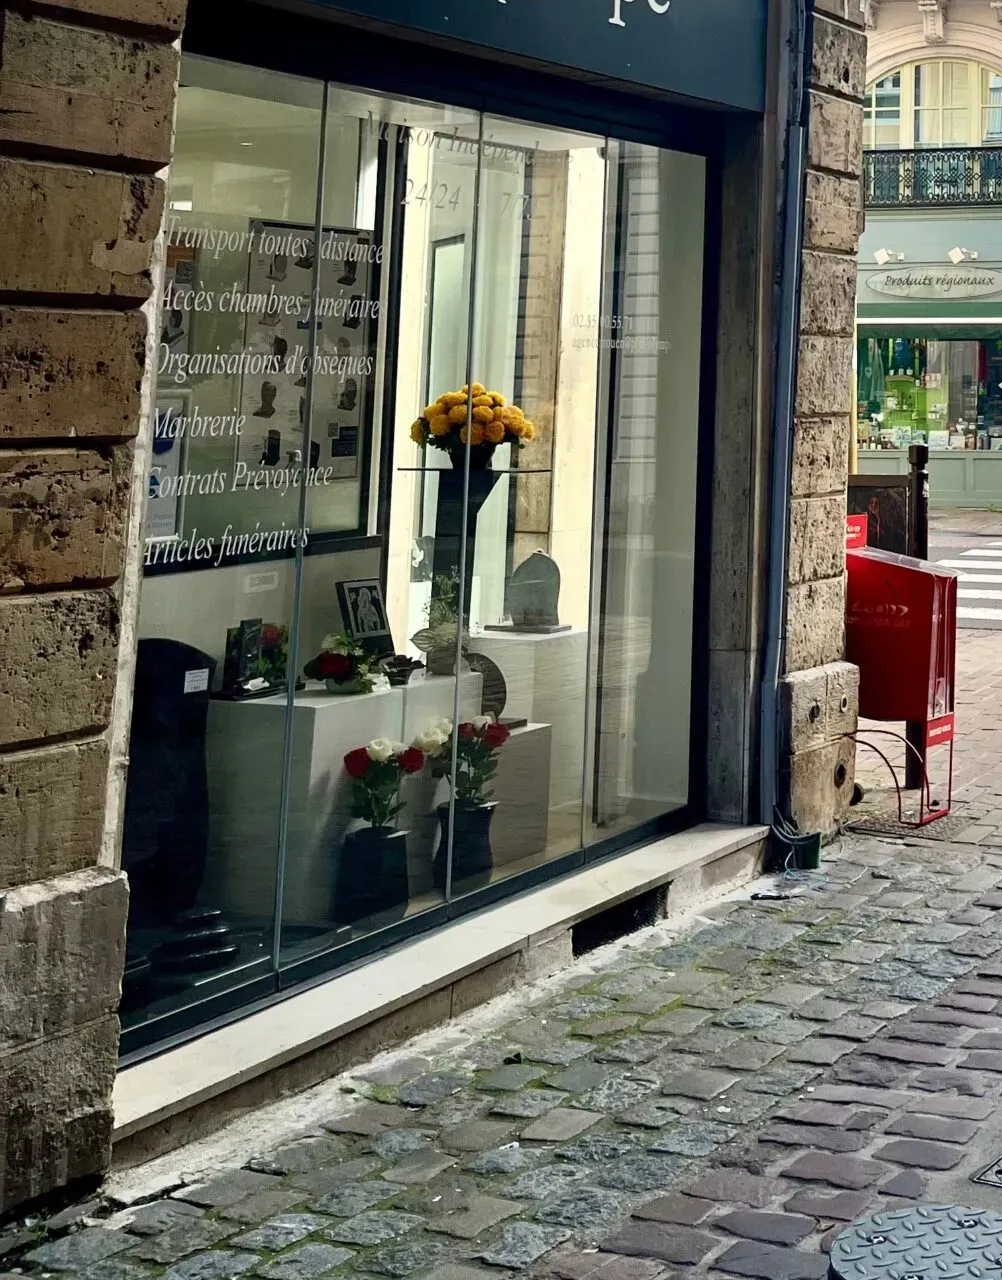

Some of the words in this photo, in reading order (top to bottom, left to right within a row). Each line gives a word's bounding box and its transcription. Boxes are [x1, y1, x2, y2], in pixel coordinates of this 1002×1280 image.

[400, 178, 462, 211] 24/24
[167, 215, 256, 260] Transport
[258, 229, 309, 258] toutes
[162, 278, 215, 312] Accès
[219, 281, 302, 316] chambres
[884, 273, 933, 287] Produits
[935, 272, 995, 292] régionaux
[153, 406, 247, 439] Marbrerie
[148, 465, 228, 499] Contrats
[231, 460, 334, 498] Prévoyance
[143, 527, 213, 566] Articles
[214, 521, 311, 567] funéraires
